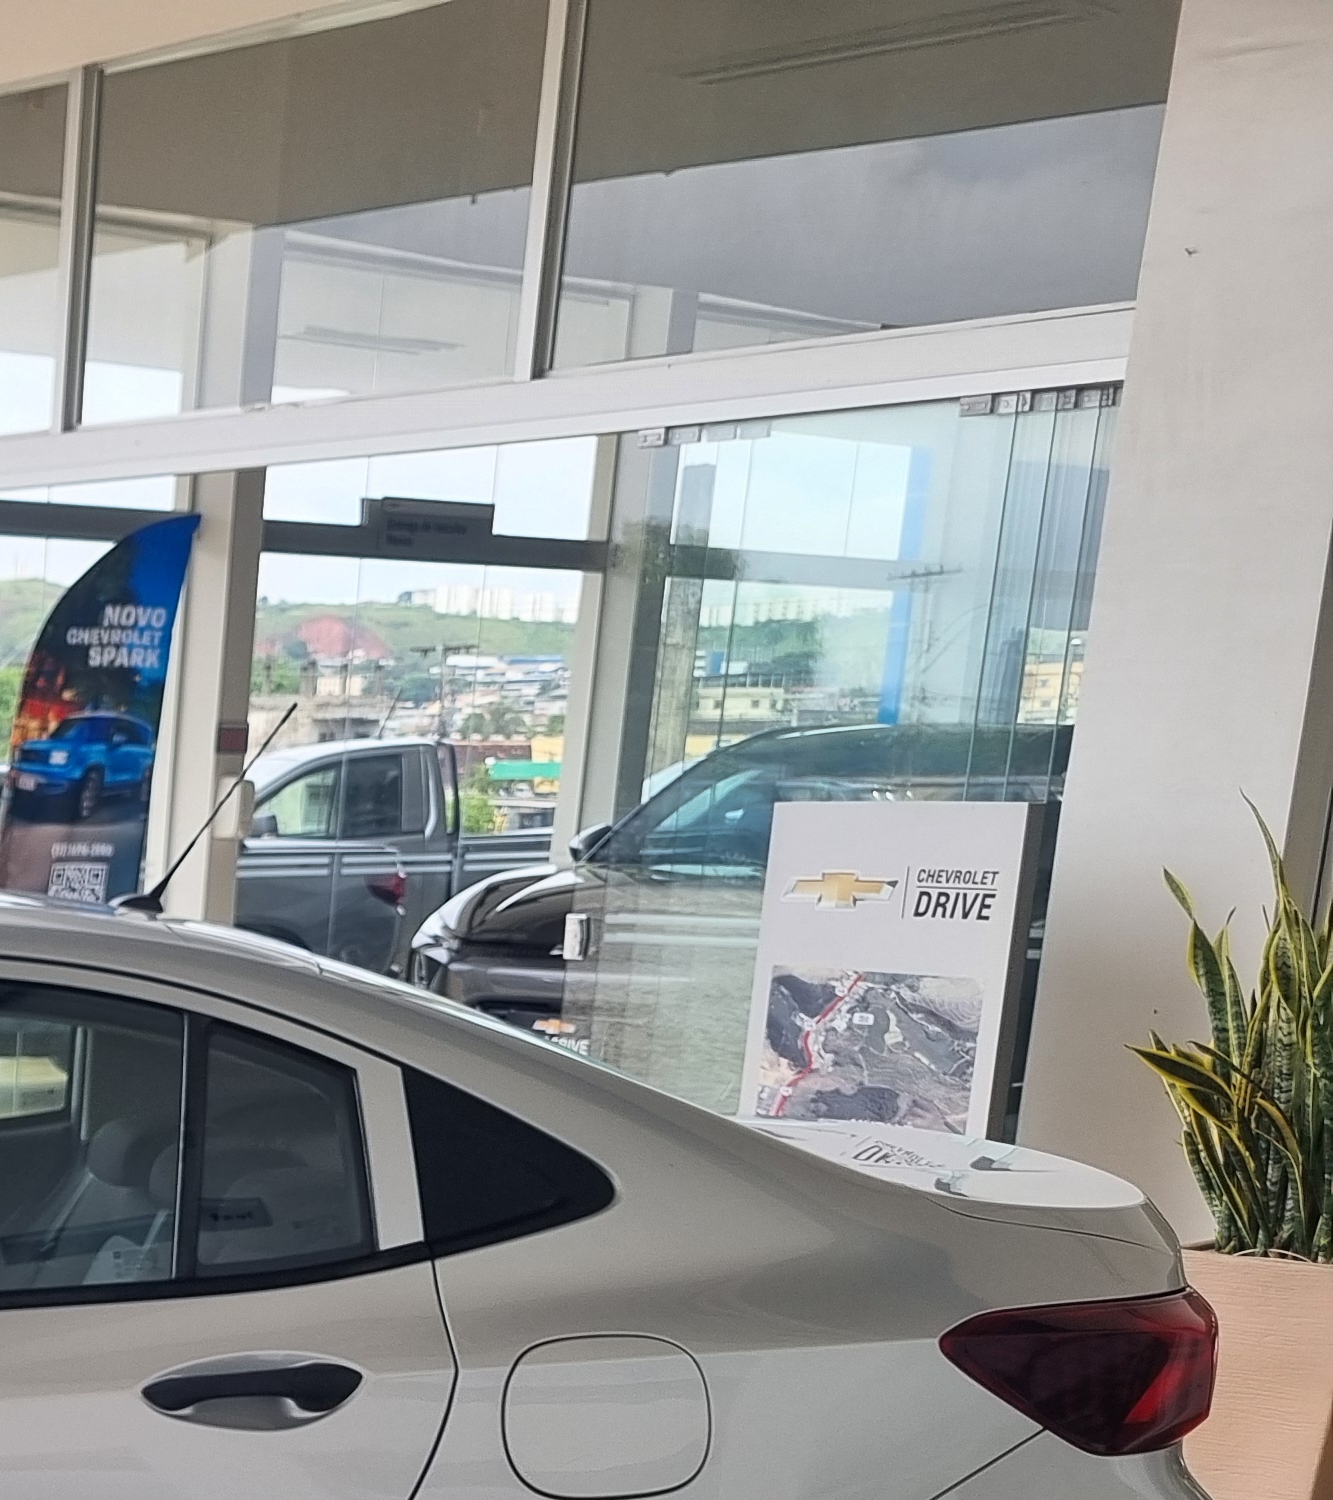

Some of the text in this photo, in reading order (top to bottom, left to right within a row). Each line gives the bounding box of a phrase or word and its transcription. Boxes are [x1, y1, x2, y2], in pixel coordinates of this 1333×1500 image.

[102, 604, 167, 627] NOVO
[66, 626, 163, 646] CHEVROLET
[87, 646, 160, 668] SPARK
[917, 868, 999, 885] CHEVROLET
[913, 890, 997, 921] DRIVE
